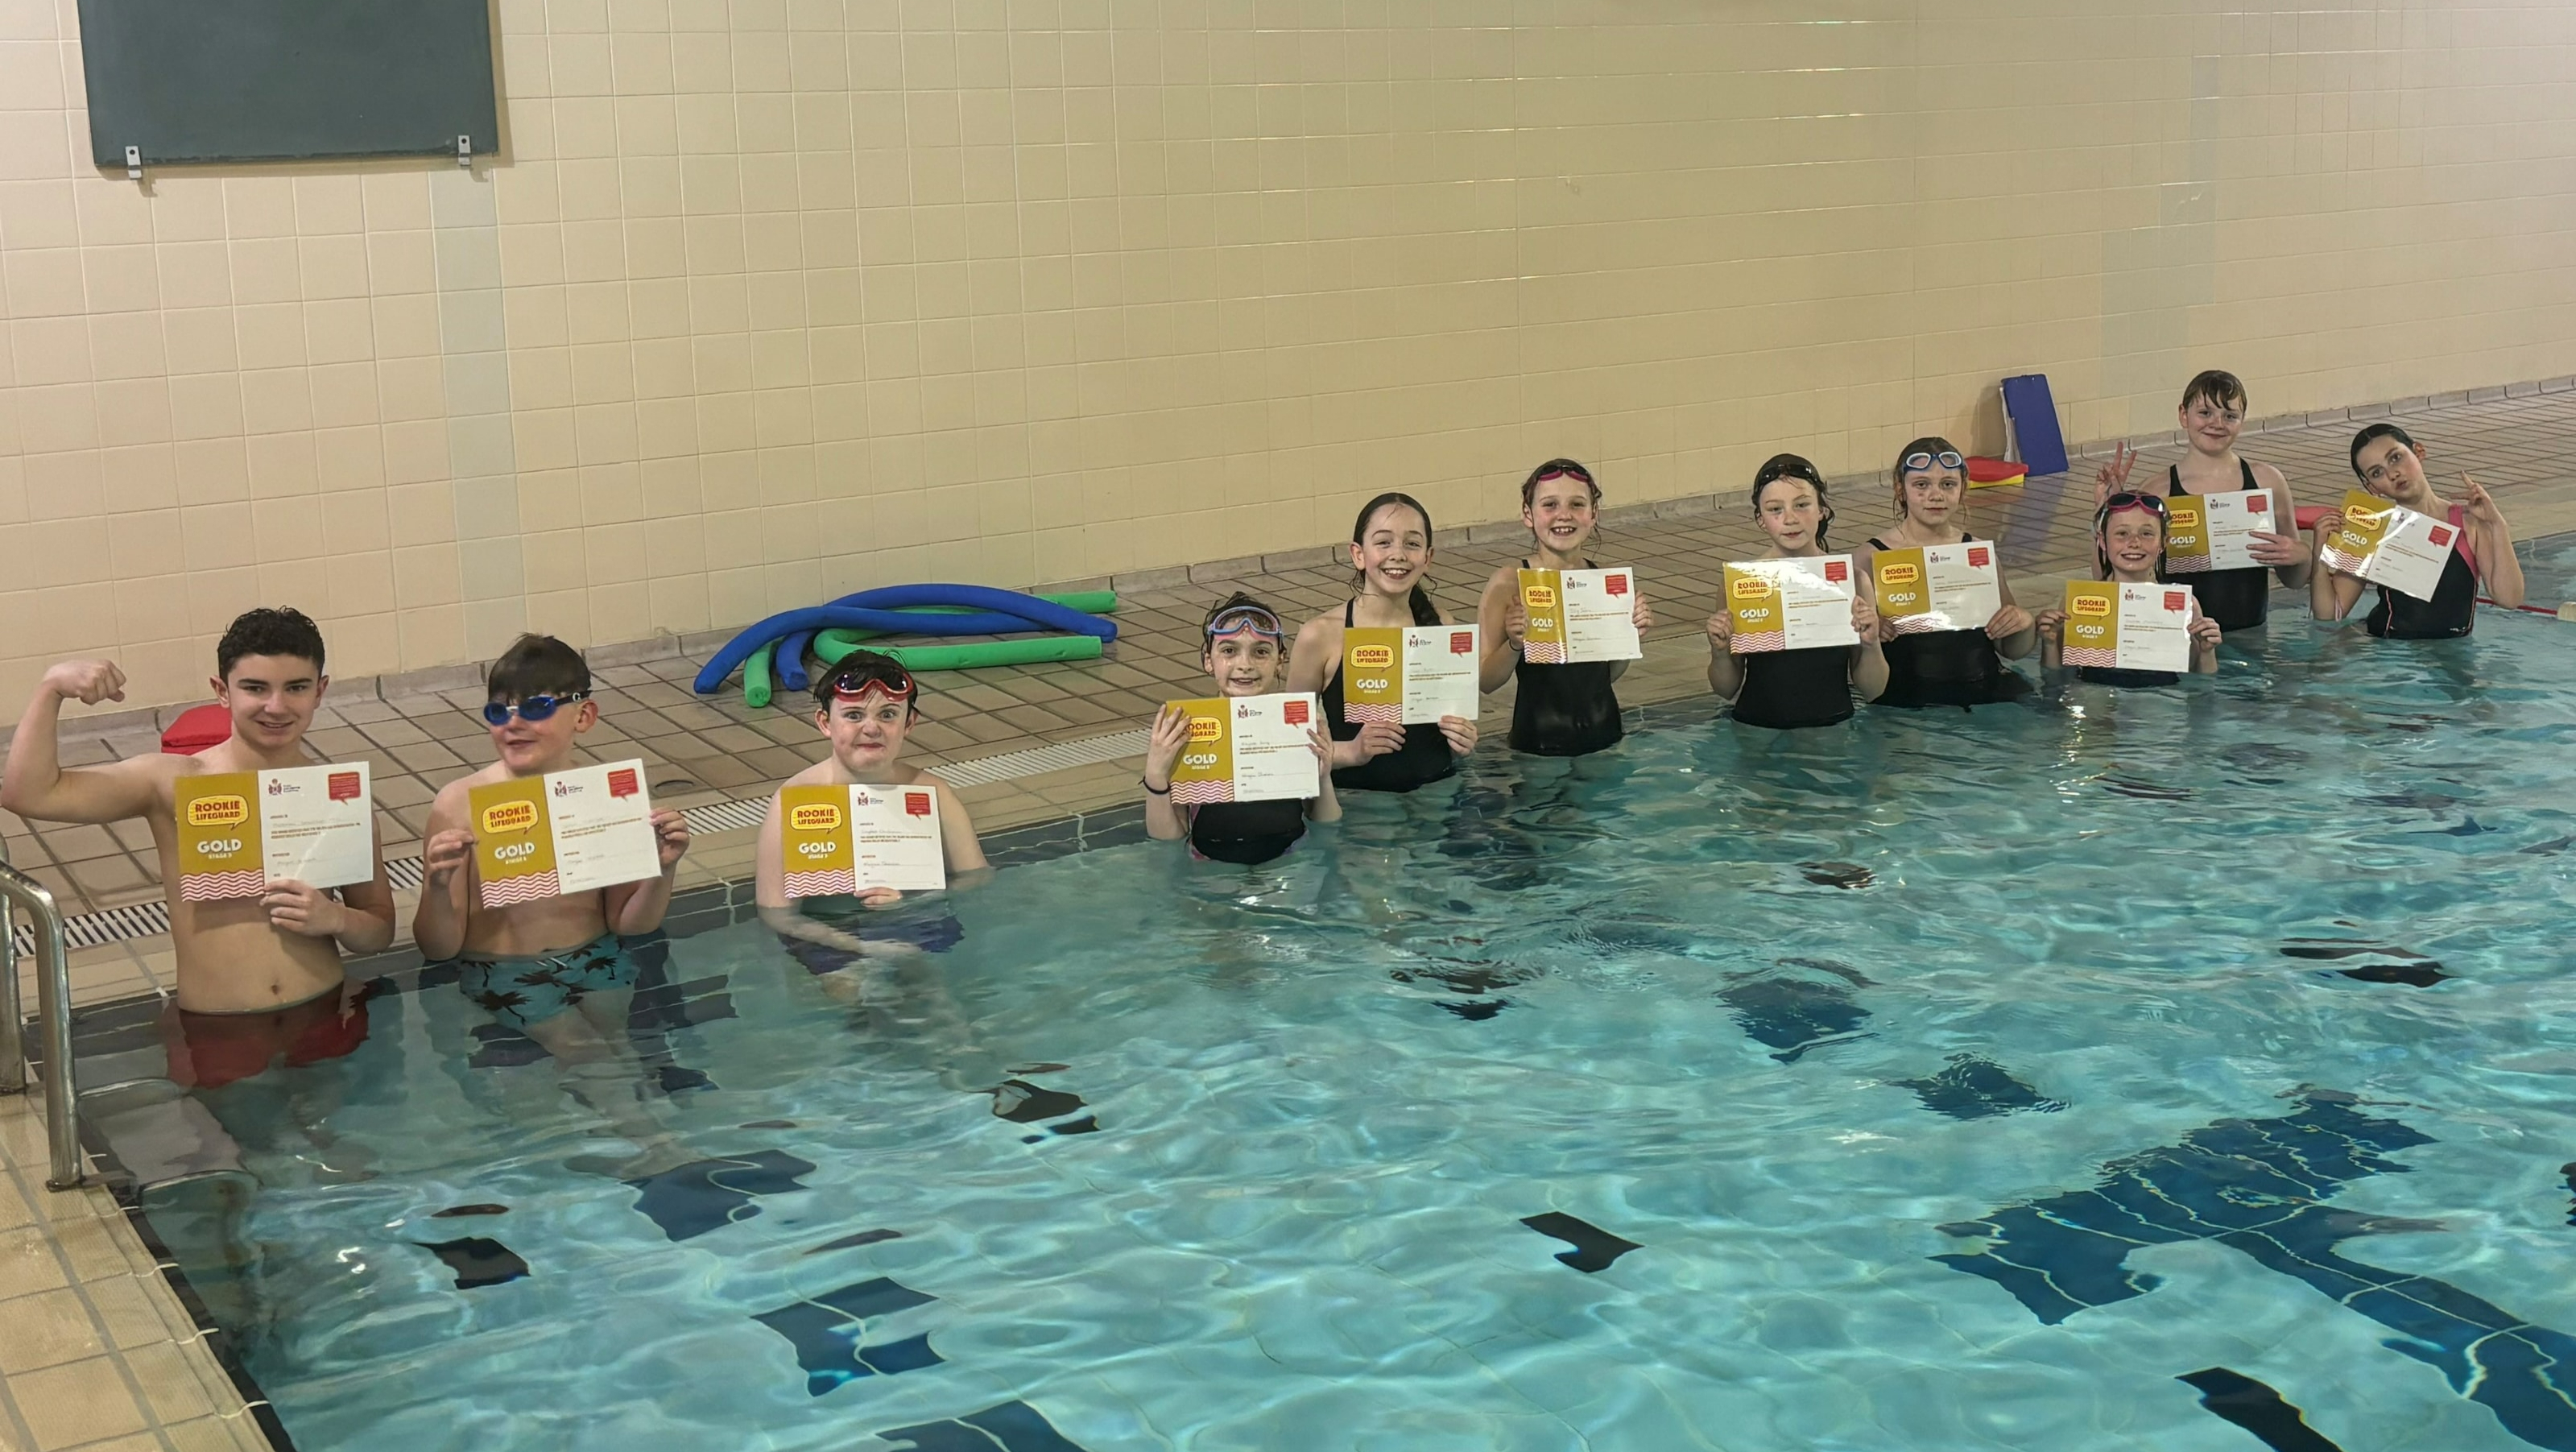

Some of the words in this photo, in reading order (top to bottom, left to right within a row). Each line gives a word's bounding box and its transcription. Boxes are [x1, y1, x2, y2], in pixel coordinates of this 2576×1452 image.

[2169, 536, 2196, 544] GOLD
[2342, 530, 2367, 545] GOLD
[1885, 567, 1913, 575] ROOKIE
[1888, 592, 1916, 602] GOLD
[1740, 608, 1769, 618] GOLD
[1532, 618, 1553, 627] GOLD
[2076, 624, 2104, 635] GOLD
[1356, 679, 1387, 689] GOLD
[1183, 753, 1217, 764] GOLD
[195, 800, 240, 813] ROOKIE
[196, 811, 240, 820] LIFEGUARD
[489, 805, 531, 820] ROOKIE
[797, 809, 834, 818] ROOKIE
[490, 815, 531, 828] LIFEGUARD
[196, 838, 242, 854] GOLD
[494, 842, 535, 859] GOLD
[798, 842, 837, 854] GOLD
